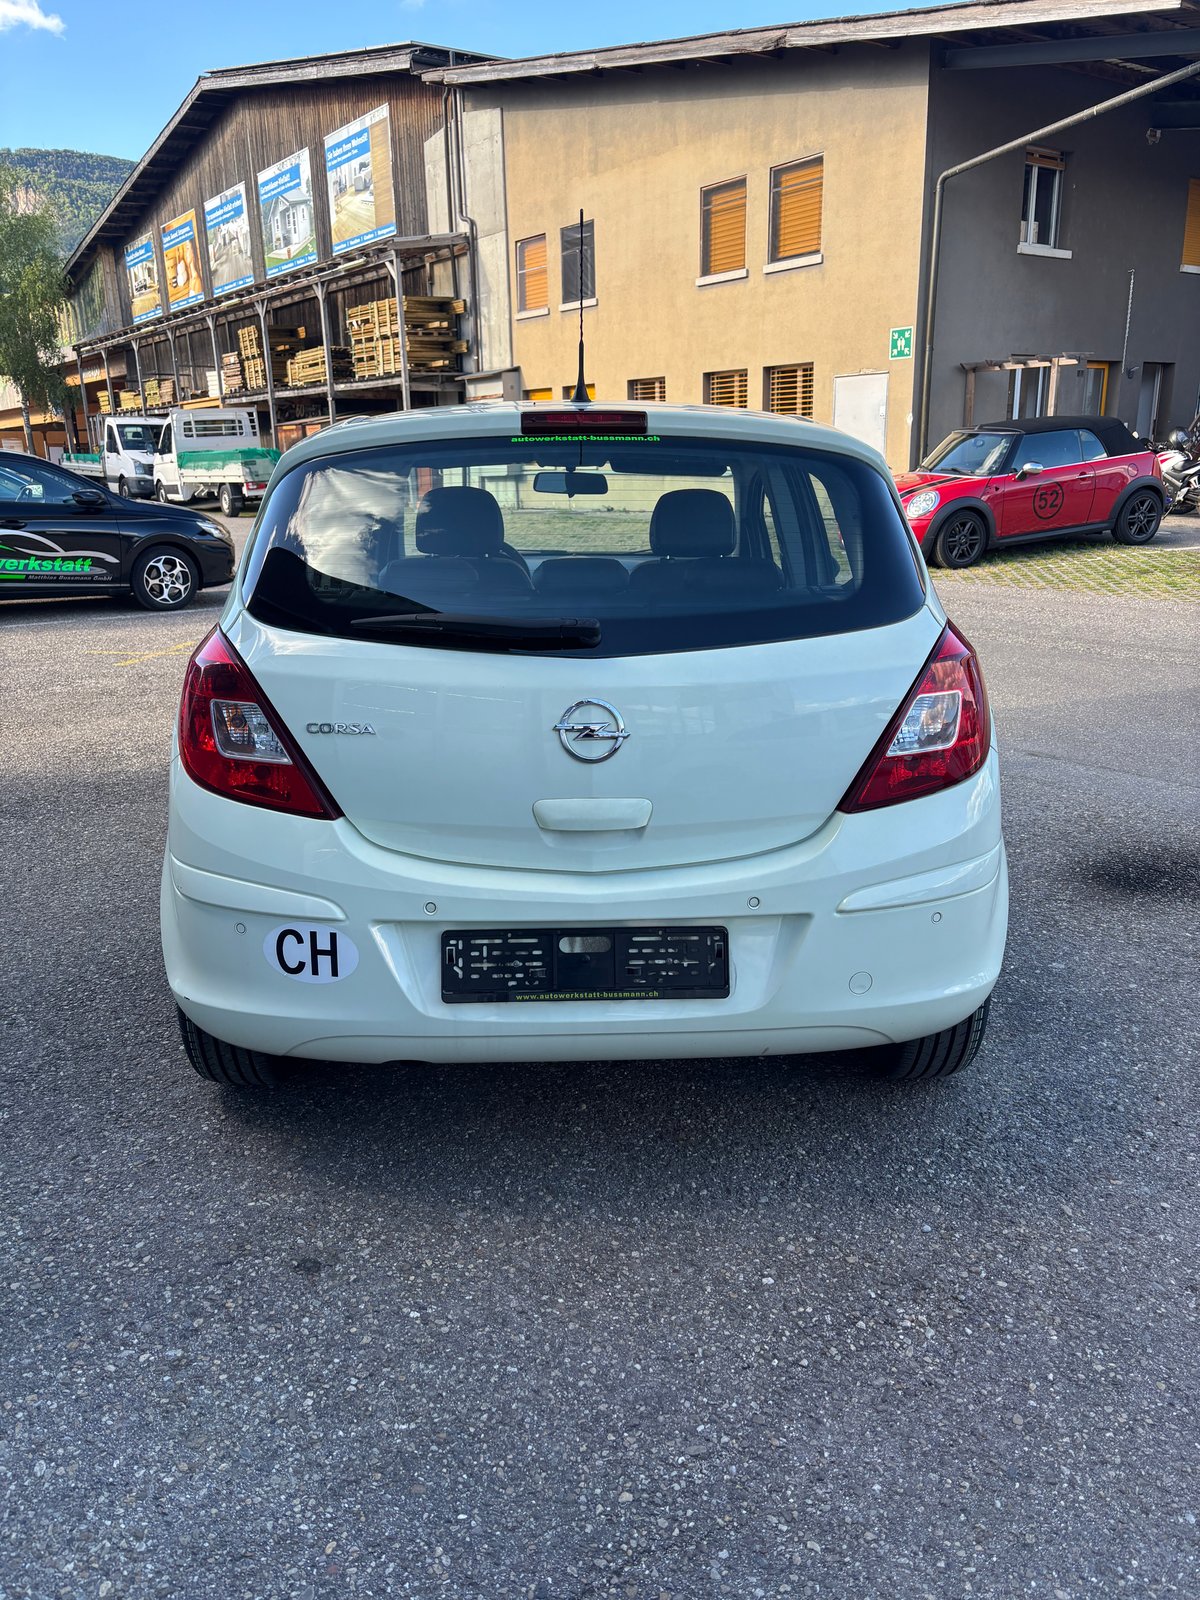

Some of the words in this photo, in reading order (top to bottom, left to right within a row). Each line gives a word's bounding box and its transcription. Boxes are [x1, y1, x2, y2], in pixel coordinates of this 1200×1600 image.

[511, 435, 661, 443] autowerkstatt-bussmann.ch
[1038, 489, 1060, 510] 52
[0, 556, 93, 572] erkstatt
[306, 722, 377, 735] CORSA
[275, 928, 340, 978] CH
[515, 990, 660, 1000] www.autowerkstatt-bussmann.ch
